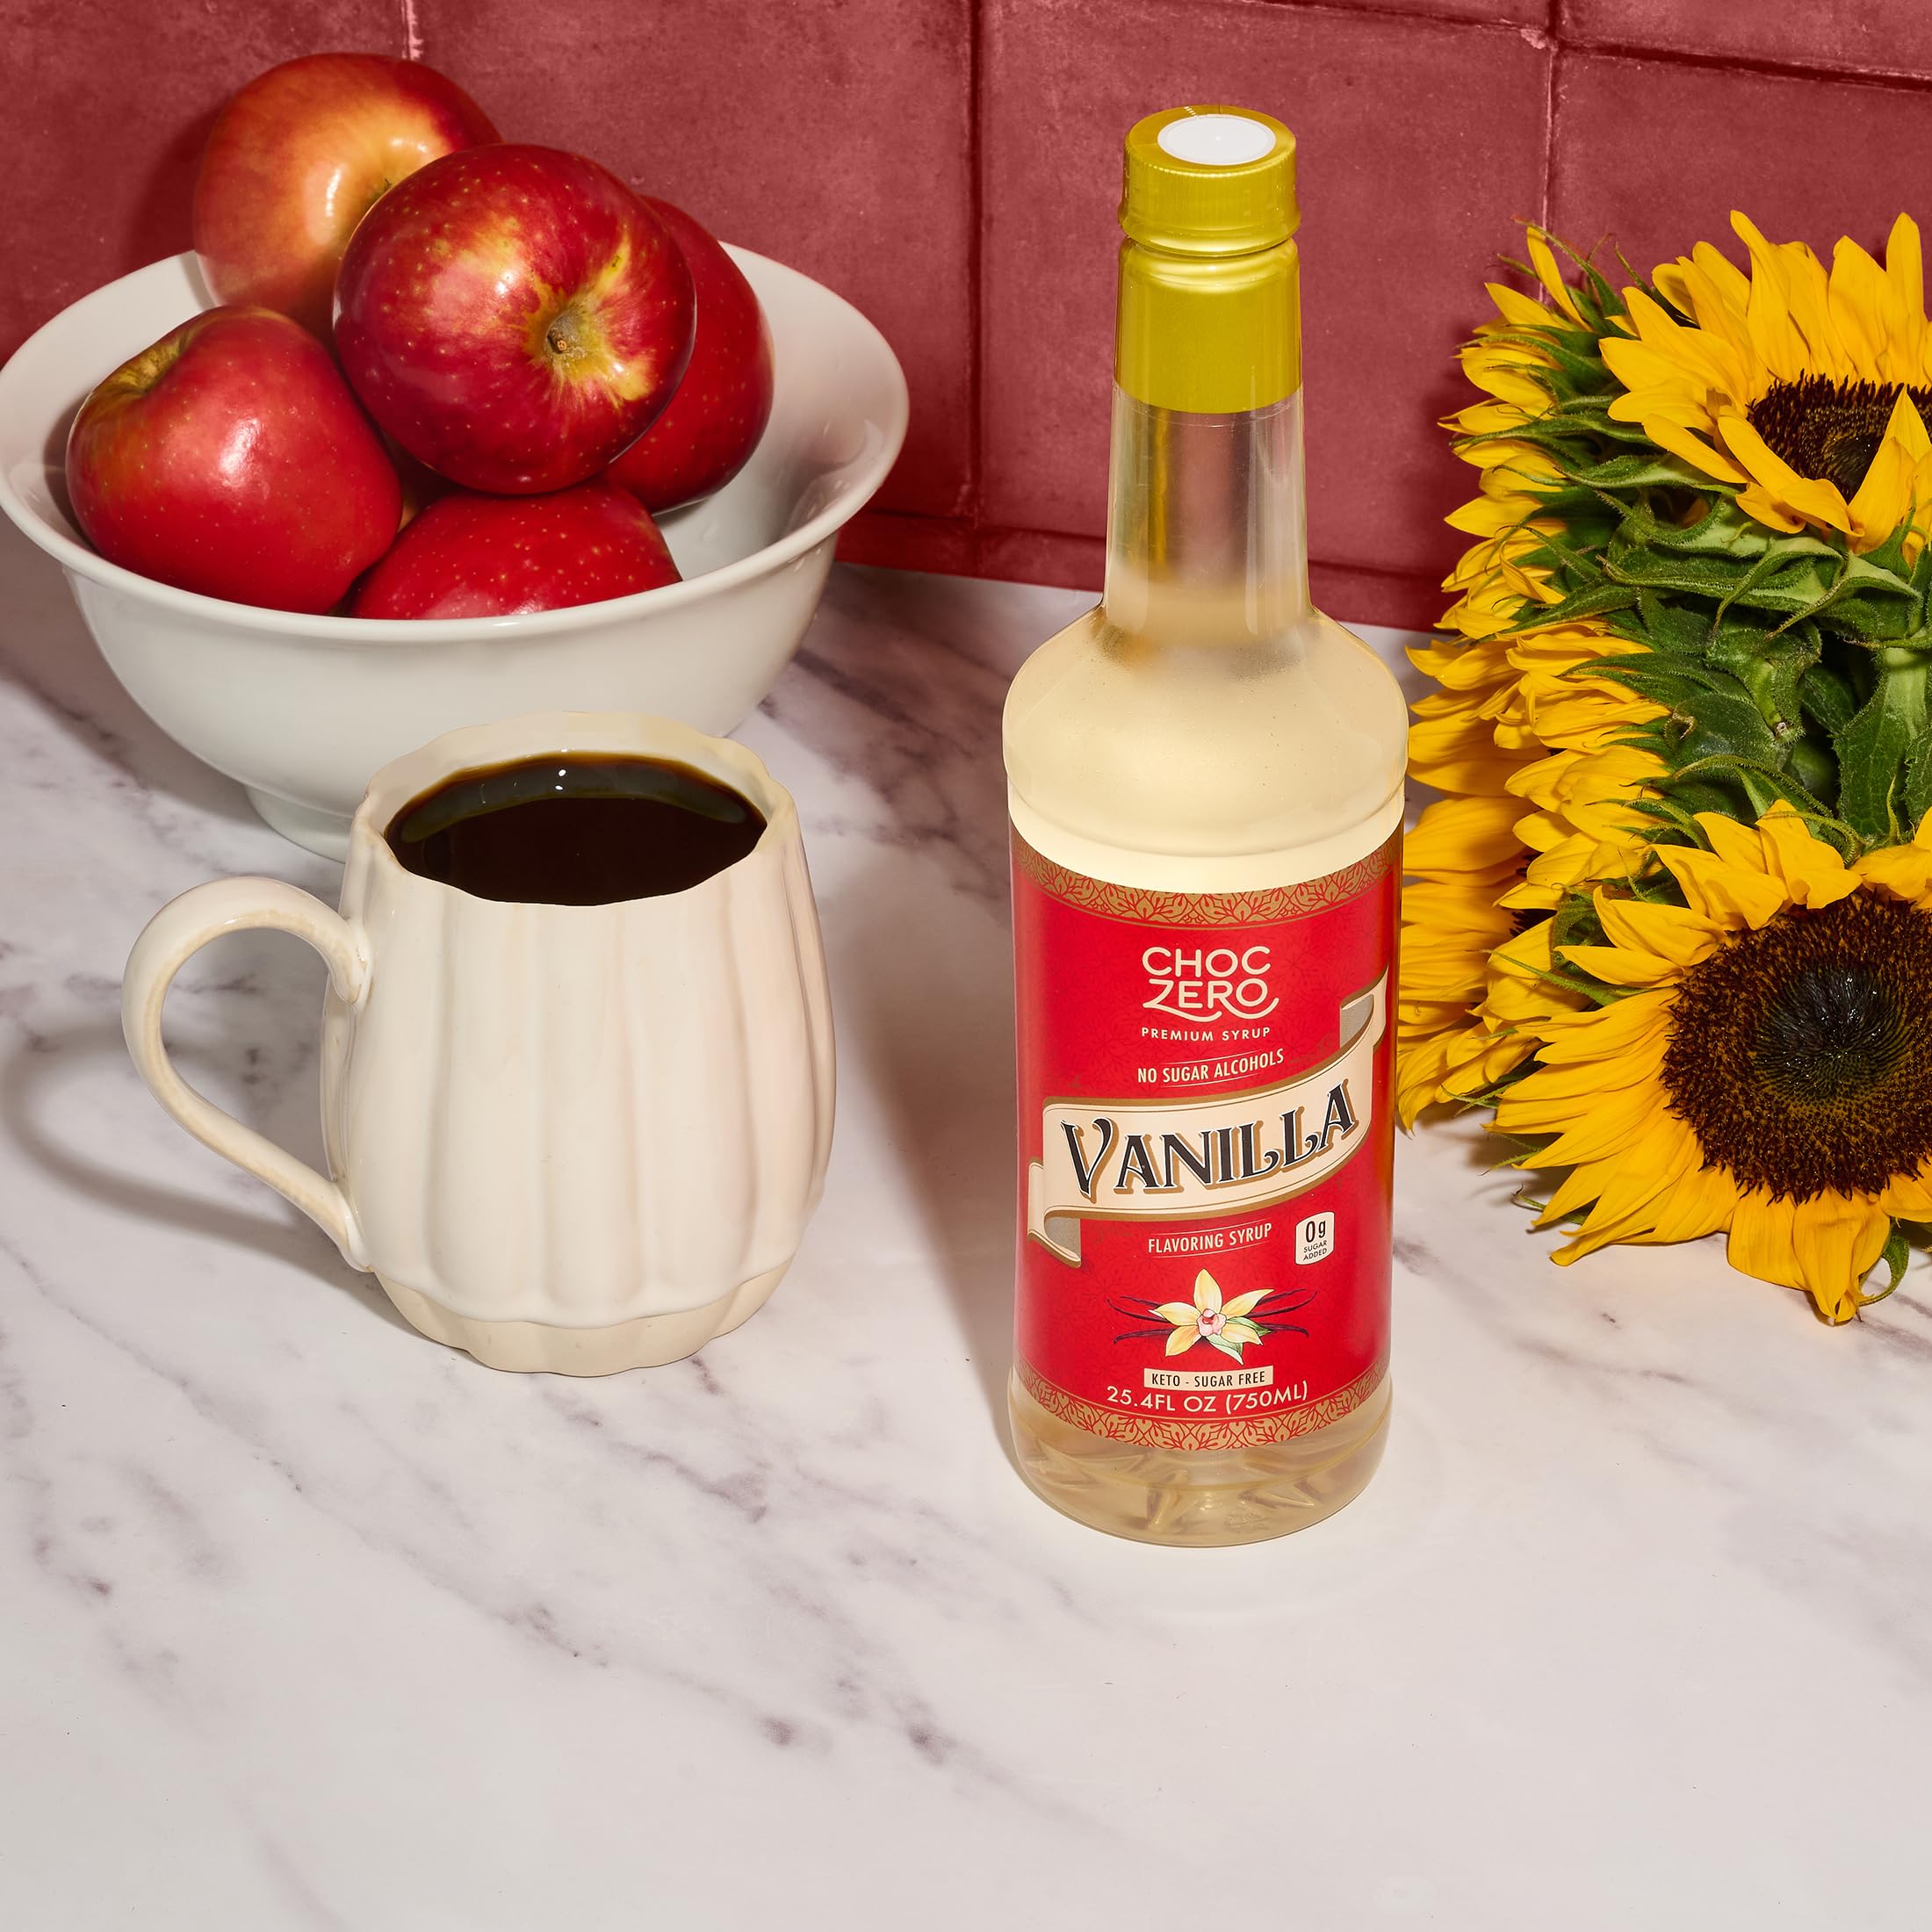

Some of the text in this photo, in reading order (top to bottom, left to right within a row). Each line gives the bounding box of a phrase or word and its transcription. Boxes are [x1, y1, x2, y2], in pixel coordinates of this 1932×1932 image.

[1142, 946, 1271, 977] CHOC
[1142, 977, 1279, 1022] ZERO
[1142, 1027, 1271, 1042] PREMIUM SYRUP
[1137, 1048, 1285, 1084] NO SUGAR ALCOHOLS
[1060, 1079, 1359, 1203] VANILLA
[1148, 1222, 1272, 1254] FLAVORING SYRUP
[1305, 1218, 1327, 1243] 0g
[1303, 1240, 1327, 1253] SUGAR
[1303, 1248, 1327, 1261] ADDED
[1151, 1373, 1181, 1387] KETO
[1194, 1373, 1234, 1387] SUGAR
[1238, 1371, 1266, 1385] FREE
[1107, 1380, 1308, 1415] 25.4FL OZ (750ML)
